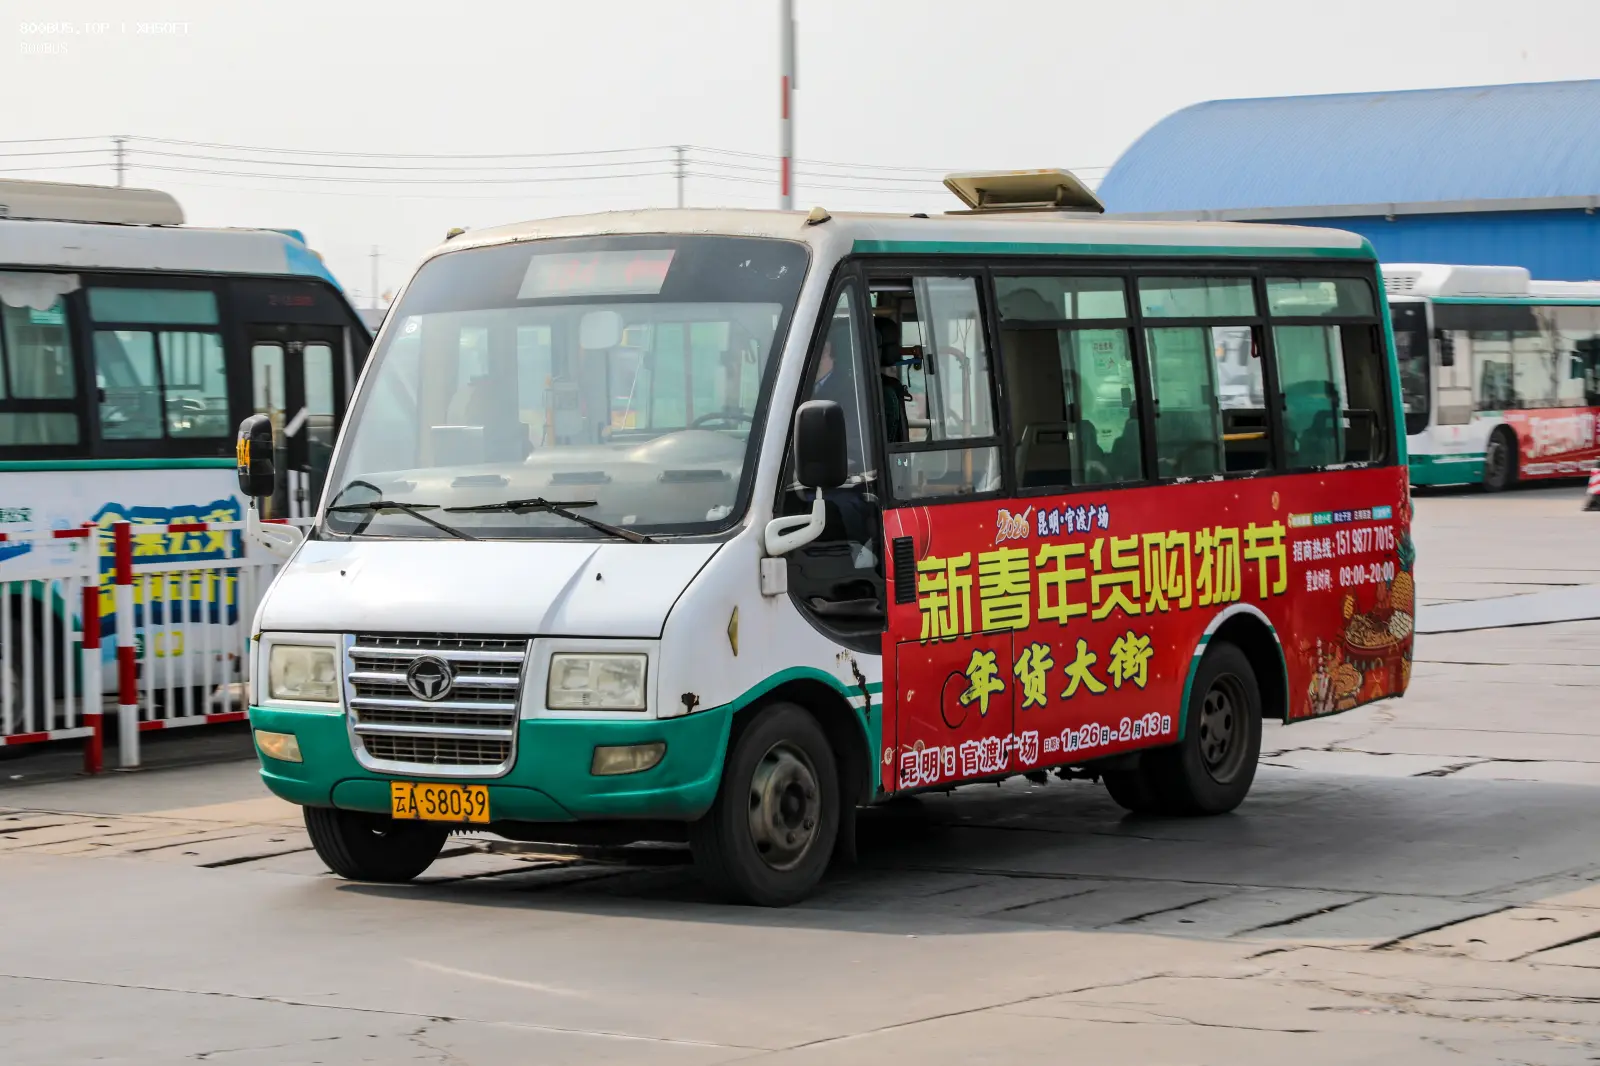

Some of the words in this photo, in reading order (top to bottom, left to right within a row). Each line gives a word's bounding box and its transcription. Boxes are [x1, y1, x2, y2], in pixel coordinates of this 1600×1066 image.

[996, 505, 1032, 545] 2026
[1036, 503, 1110, 537] 昆明·官渡广场
[917, 520, 1289, 645] 新春年货购物节
[959, 630, 1155, 717] 年货大街
[394, 787, 486, 816] 云A·S8039
